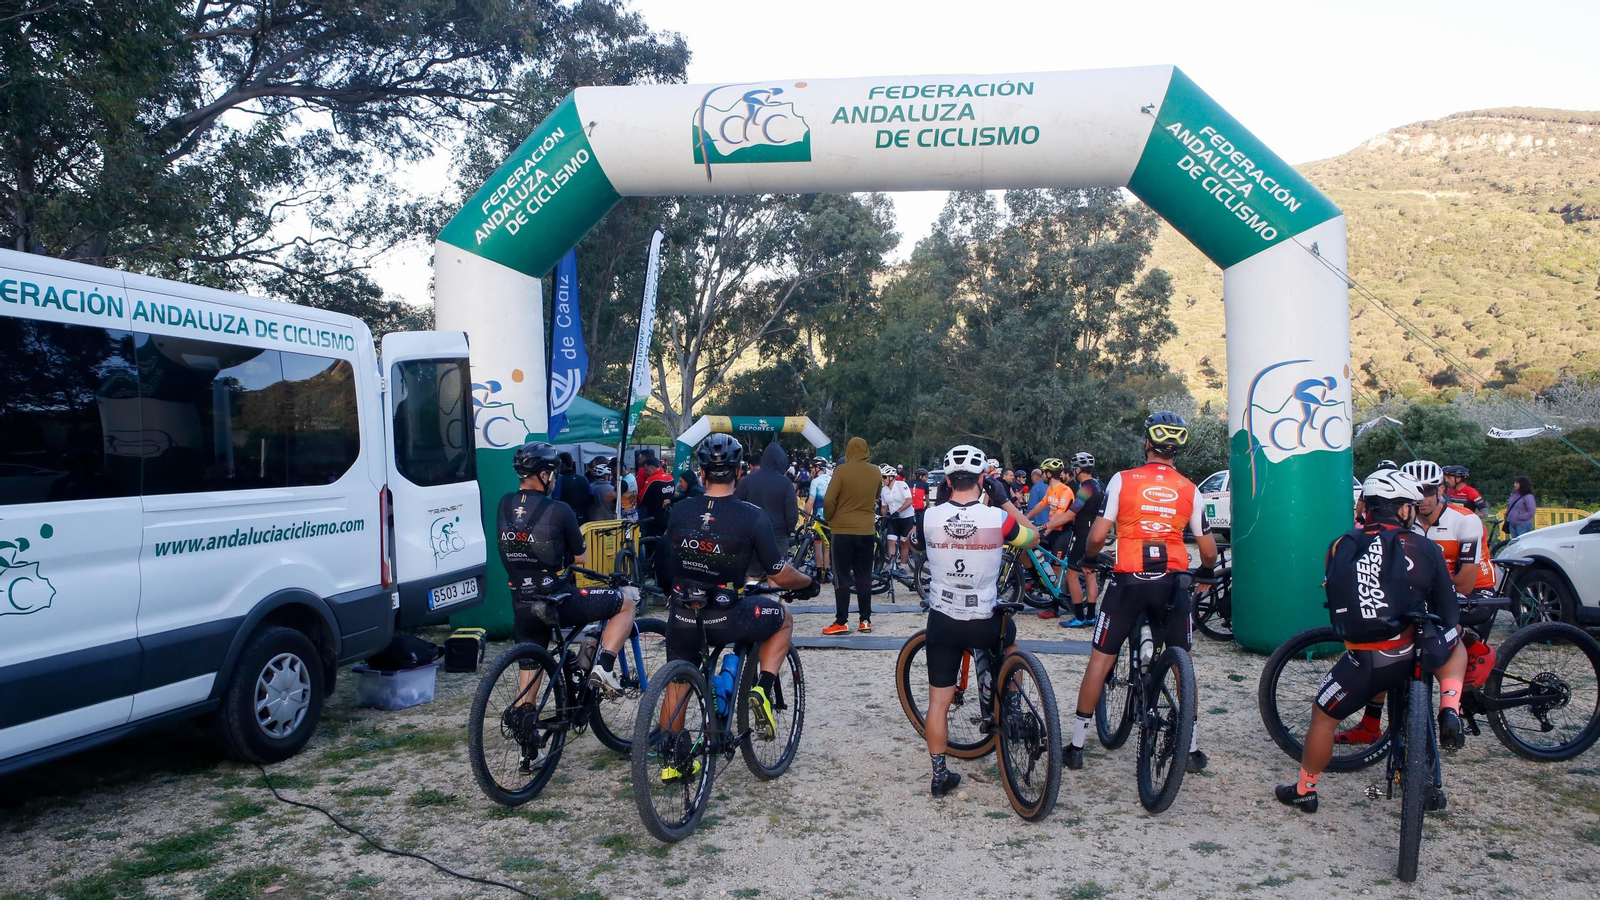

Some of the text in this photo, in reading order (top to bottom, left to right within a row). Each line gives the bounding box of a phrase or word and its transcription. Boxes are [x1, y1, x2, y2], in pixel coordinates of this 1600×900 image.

[868, 80, 1035, 100] FEDERACIÓN
[831, 102, 976, 124] ANDALUZA
[875, 125, 1041, 148] DE CICLISMO
[481, 126, 566, 215] FEDERACIÓN
[1165, 122, 1253, 199] ANDALUZA
[1198, 125, 1302, 213] FEDERACIÓN
[505, 148, 591, 236] DE CICLISMO
[1176, 154, 1278, 242] DE CICLISMO
[475, 169, 549, 246] ANDALUZA
[0, 277, 356, 353] ERACIÓN ANDALUZA DE CICLISMO
[560, 335, 577, 360] de
[738, 424, 776, 432] DEPORTES
[428, 503, 464, 516] TRANSIT
[153, 516, 366, 559] www.andaluciaciclismo.com
[501, 531, 535, 543] AOSSA
[681, 538, 721, 554] AOSSA
[950, 543, 997, 551] PATERNA
[1368, 534, 1389, 610] YOURSEL
[433, 580, 477, 604] 6503 JZG
[703, 615, 728, 625] MORENO
[761, 607, 780, 615] aero
